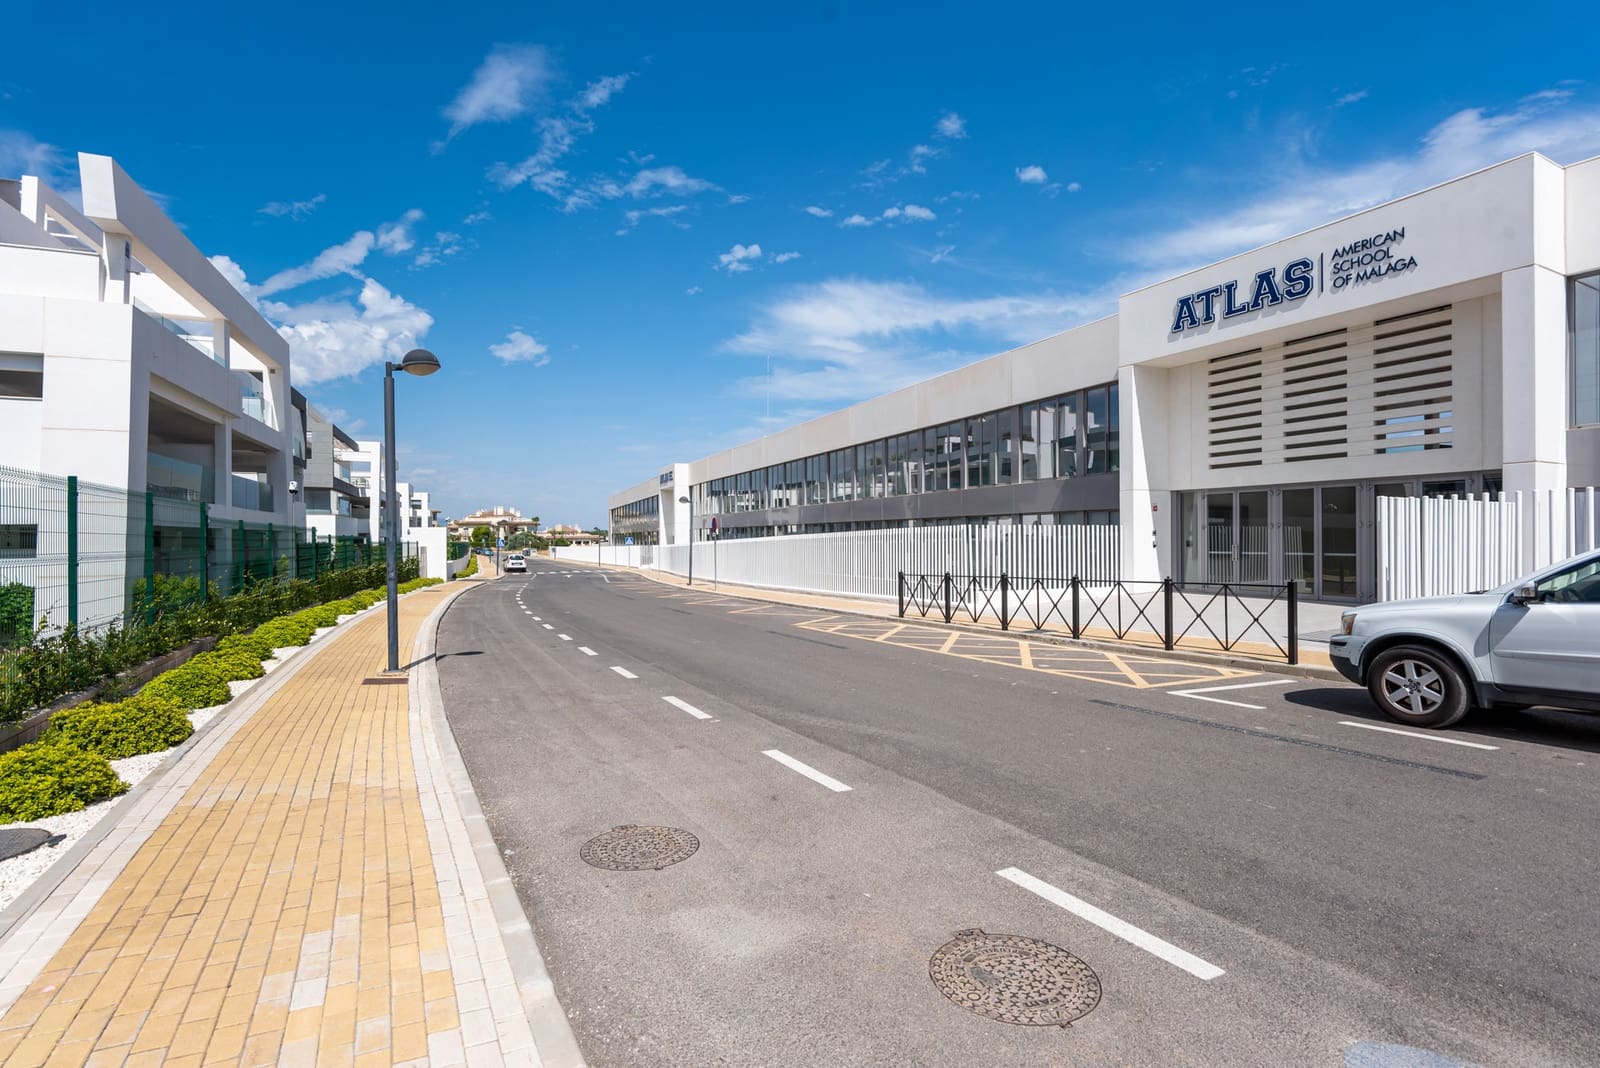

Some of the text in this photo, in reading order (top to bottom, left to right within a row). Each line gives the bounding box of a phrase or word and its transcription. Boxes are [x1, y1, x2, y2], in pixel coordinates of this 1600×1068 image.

[1332, 226, 1405, 261] AMERICAN
[1333, 247, 1394, 275] SCHOOL
[1333, 256, 1418, 289] OF MALAGA
[1171, 257, 1313, 333] ATLAS
